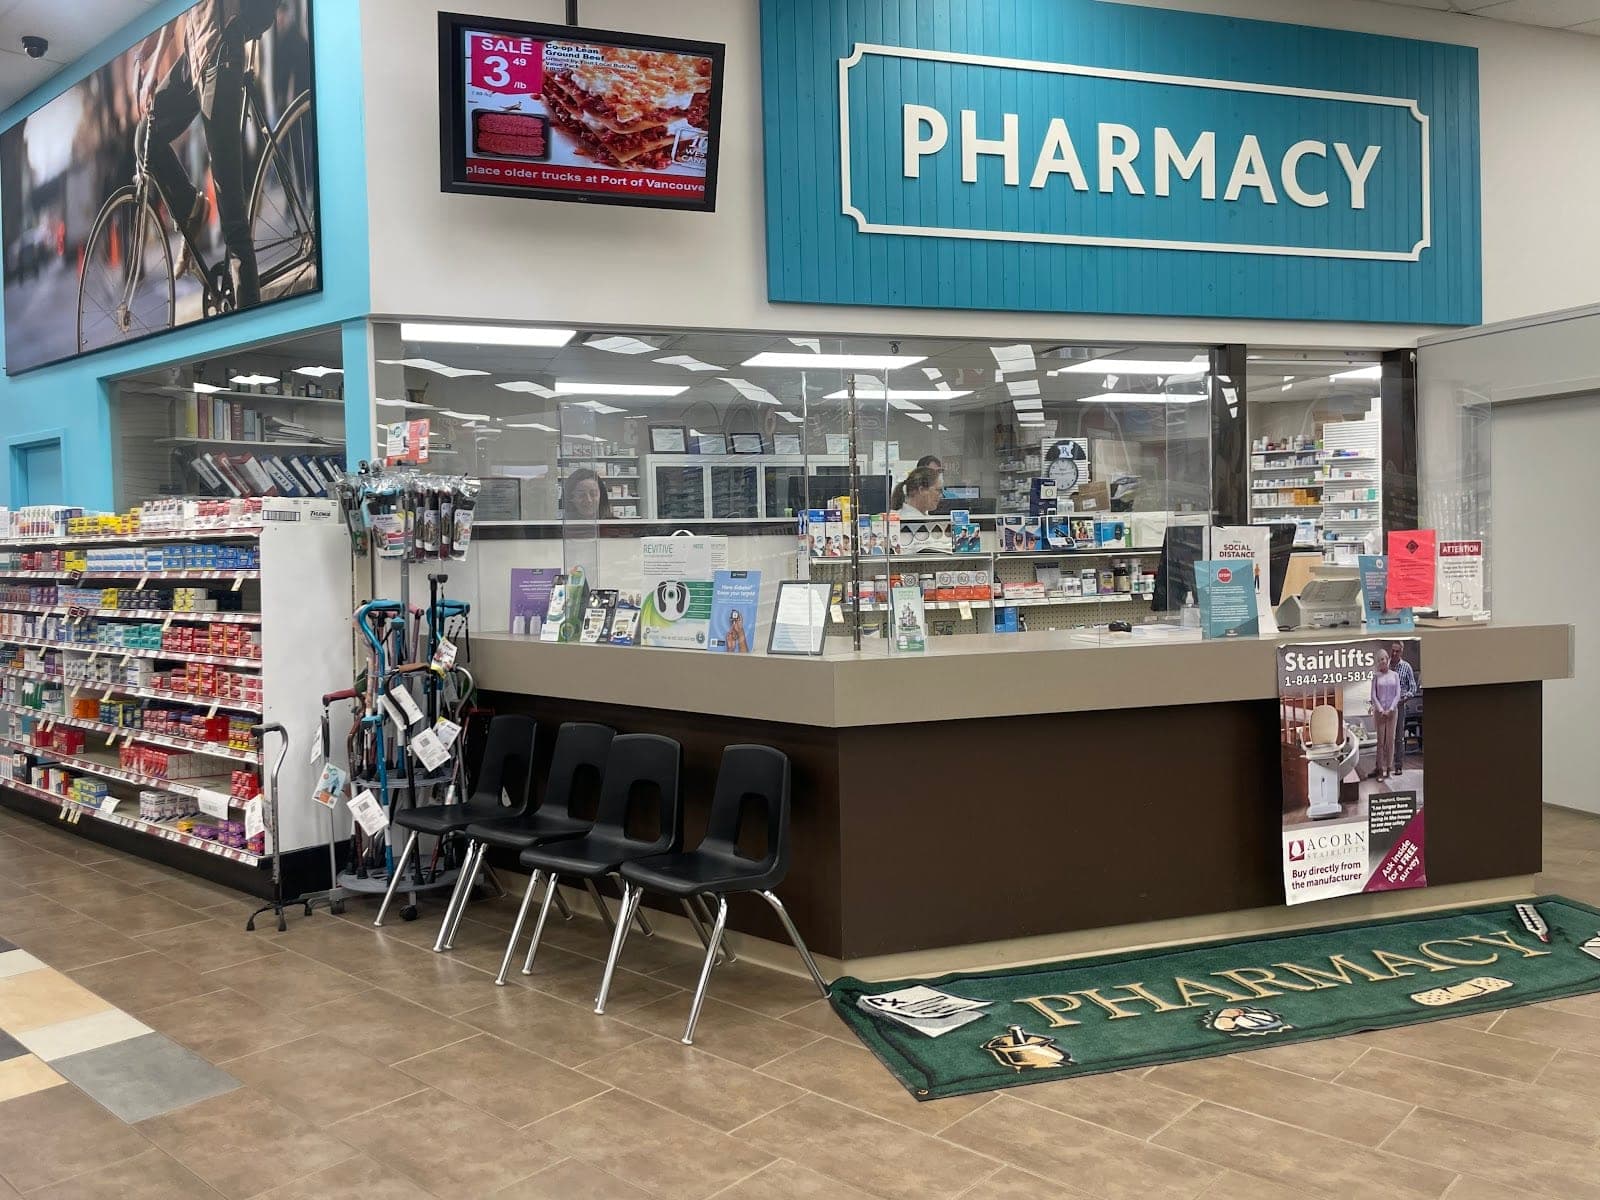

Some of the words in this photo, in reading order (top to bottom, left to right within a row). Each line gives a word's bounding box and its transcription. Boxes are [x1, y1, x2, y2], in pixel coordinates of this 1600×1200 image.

[481, 38, 532, 55] SALE
[545, 43, 573, 52] Co-op
[576, 46, 599, 54] Lean
[545, 49, 580, 59] Ground
[513, 58, 527, 66] 49
[483, 56, 510, 87] 3
[901, 103, 1382, 209] PHARMACY
[466, 166, 500, 180] place
[504, 168, 538, 180] older
[542, 171, 582, 182] trucks
[585, 174, 597, 183] at
[600, 176, 627, 186] Port
[630, 177, 644, 187] of
[1443, 544, 1479, 553] ATTENTION
[1285, 648, 1374, 672] Stairlifts
[1285, 671, 1373, 687] 1-844-210-5814
[1307, 831, 1365, 851] ACORN
[1292, 870, 1307, 879] Buy
[1309, 863, 1339, 876] directly
[1341, 862, 1361, 870] from
[1382, 861, 1395, 877] Ask
[1388, 869, 1399, 883] for
[1400, 843, 1418, 866] FREE
[1399, 856, 1420, 882] survey
[1292, 881, 1305, 890] the
[1306, 873, 1362, 887] manufacturer
[1013, 930, 1552, 1028] PHARMACY
